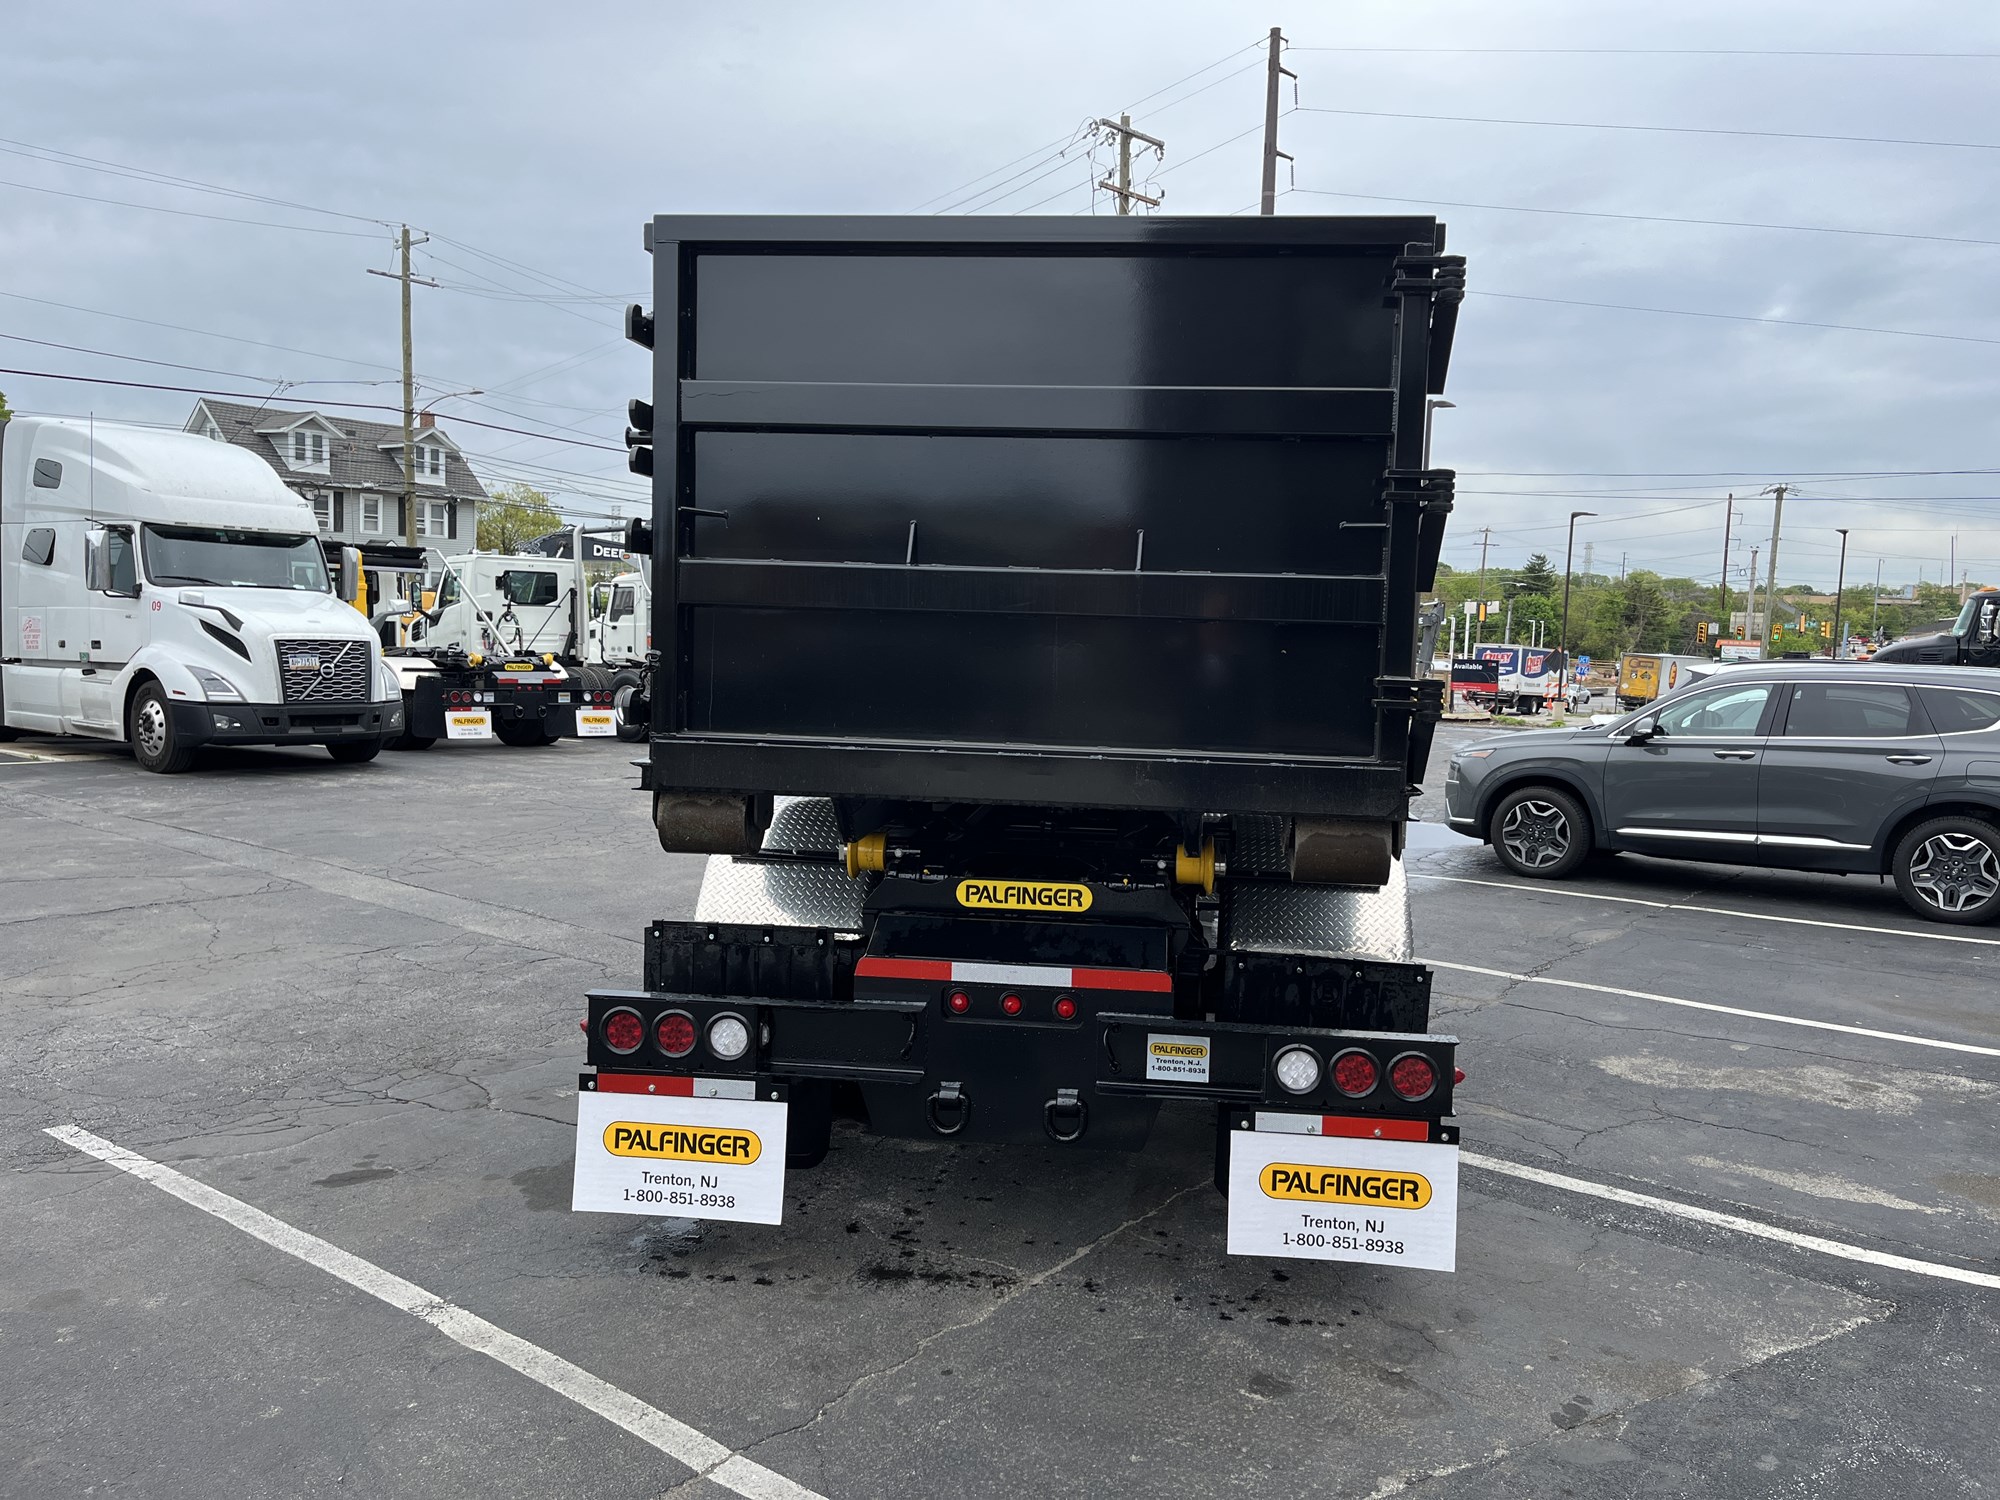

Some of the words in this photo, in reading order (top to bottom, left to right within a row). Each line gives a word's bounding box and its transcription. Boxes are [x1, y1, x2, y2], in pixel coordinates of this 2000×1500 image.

[151, 600, 161, 611] 09
[453, 717, 485, 725] PALFINGER
[965, 884, 1083, 907] PALFINGER
[1153, 1045, 1204, 1056] PALFINGER
[1151, 1065, 1206, 1074] 1-800-851-8938
[1155, 1057, 1186, 1066] Trenton,
[614, 1128, 750, 1158] PALFINGER
[641, 1171, 695, 1189] Trenton,
[700, 1175, 718, 1189] NJ
[1271, 1169, 1419, 1202] PALFINGER
[623, 1189, 735, 1209] 1-800-851-8938
[1301, 1215, 1360, 1234] Trenton,
[1365, 1219, 1385, 1233] NJ
[1282, 1232, 1404, 1254] 1-800-851-8938
